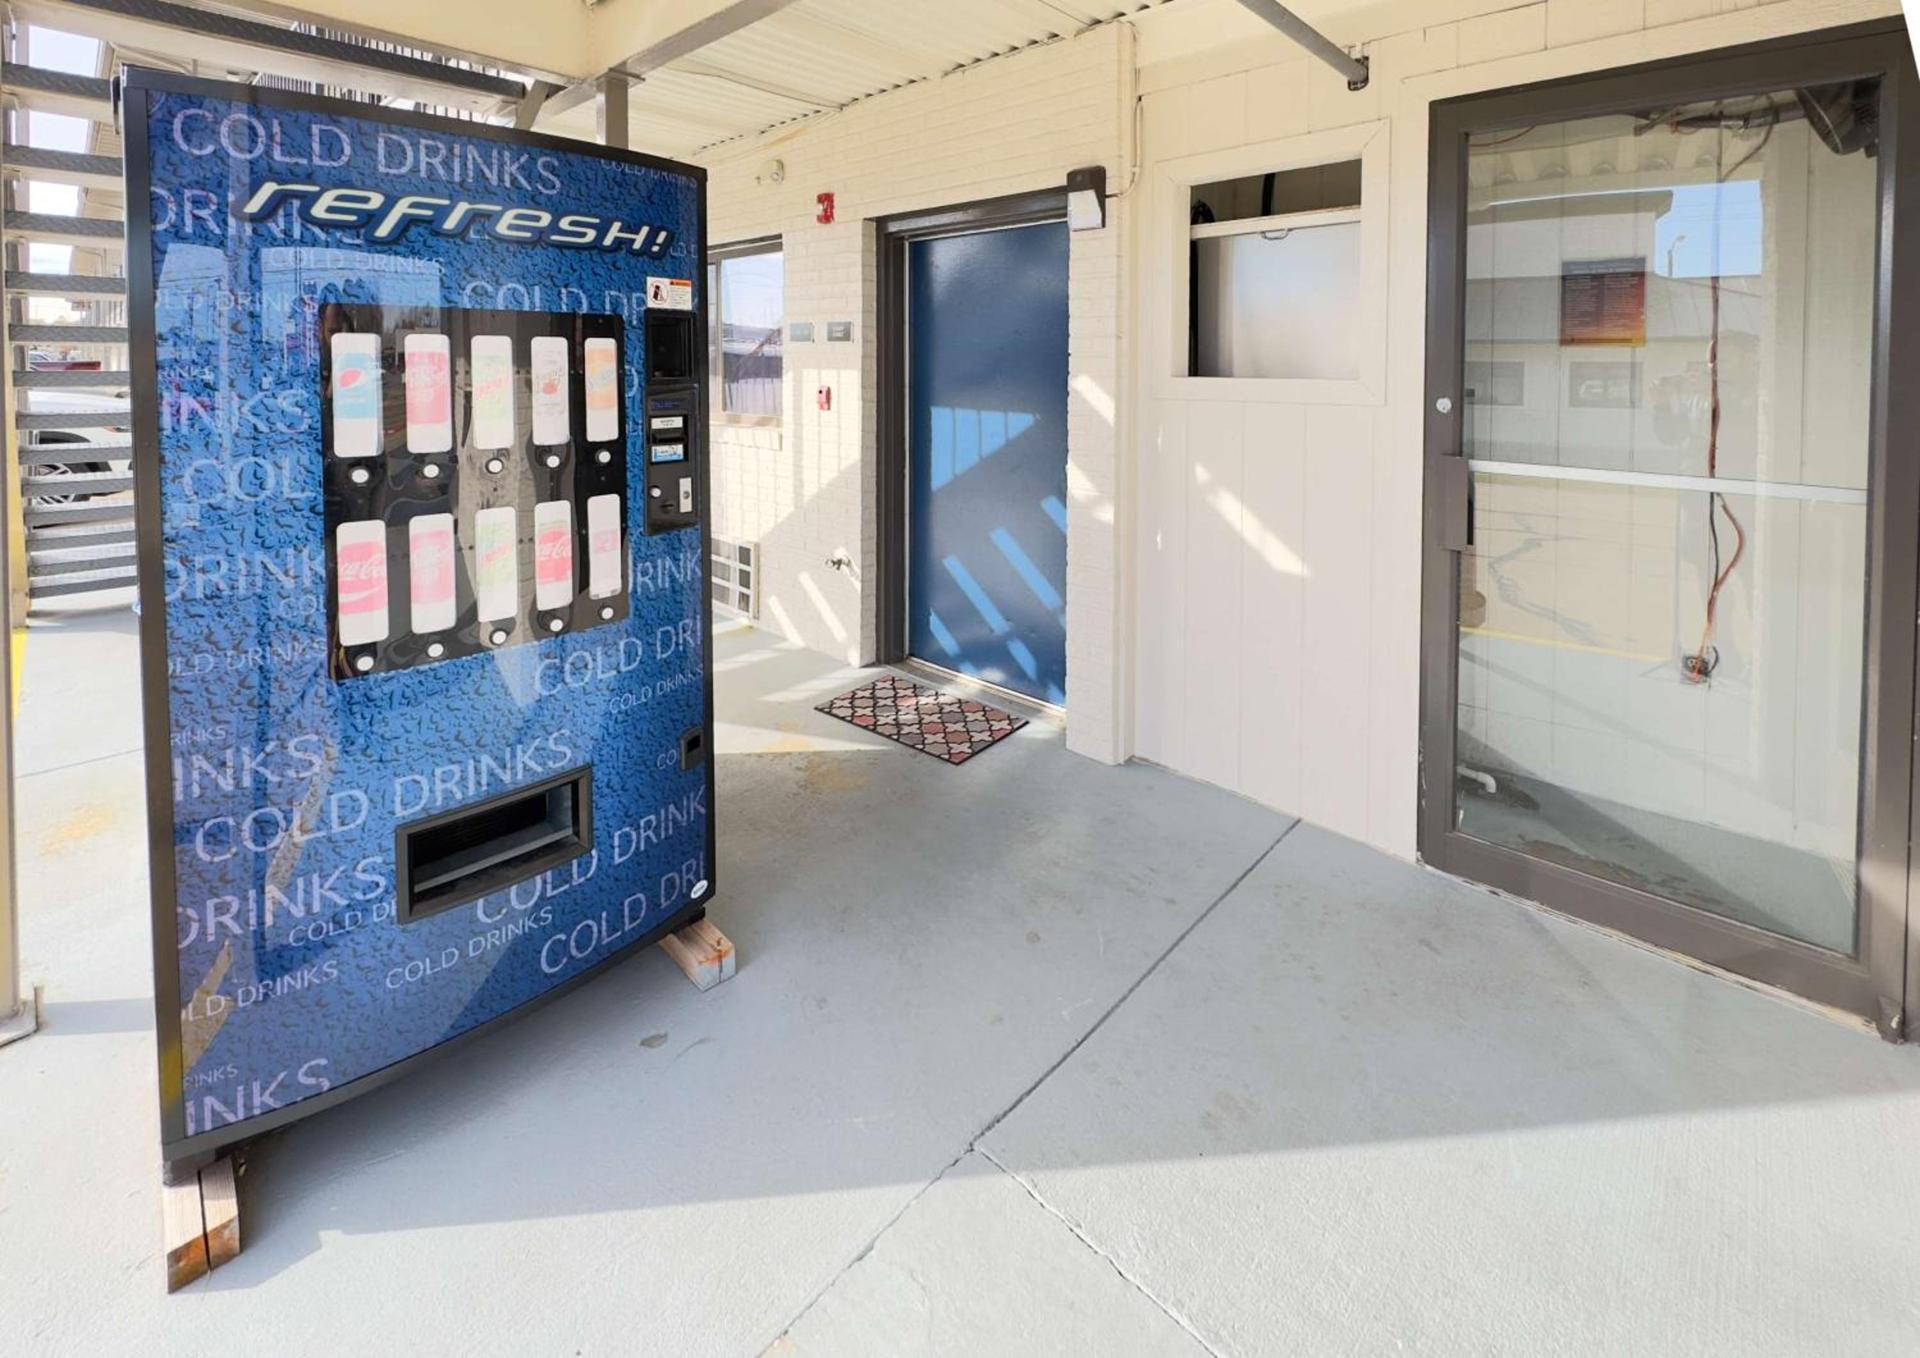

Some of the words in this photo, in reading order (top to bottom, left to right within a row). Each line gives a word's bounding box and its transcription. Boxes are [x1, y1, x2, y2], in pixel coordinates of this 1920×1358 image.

[173, 108, 351, 168] COLD
[377, 132, 561, 196] DRINKS
[534, 637, 643, 696] COLD
[657, 613, 700, 661] DRI
[609, 685, 653, 714] COLD
[173, 733, 323, 801] INKS
[195, 788, 369, 863] COLD
[393, 729, 573, 818] DRINKS
[613, 784, 706, 865] DRINK
[289, 910, 363, 947] COLD
[386, 946, 459, 990] COLD
[468, 905, 553, 959] DRINKS
[540, 892, 648, 974] COLD
[237, 959, 339, 1008] DRINKS
[186, 1057, 330, 1137] INKS
